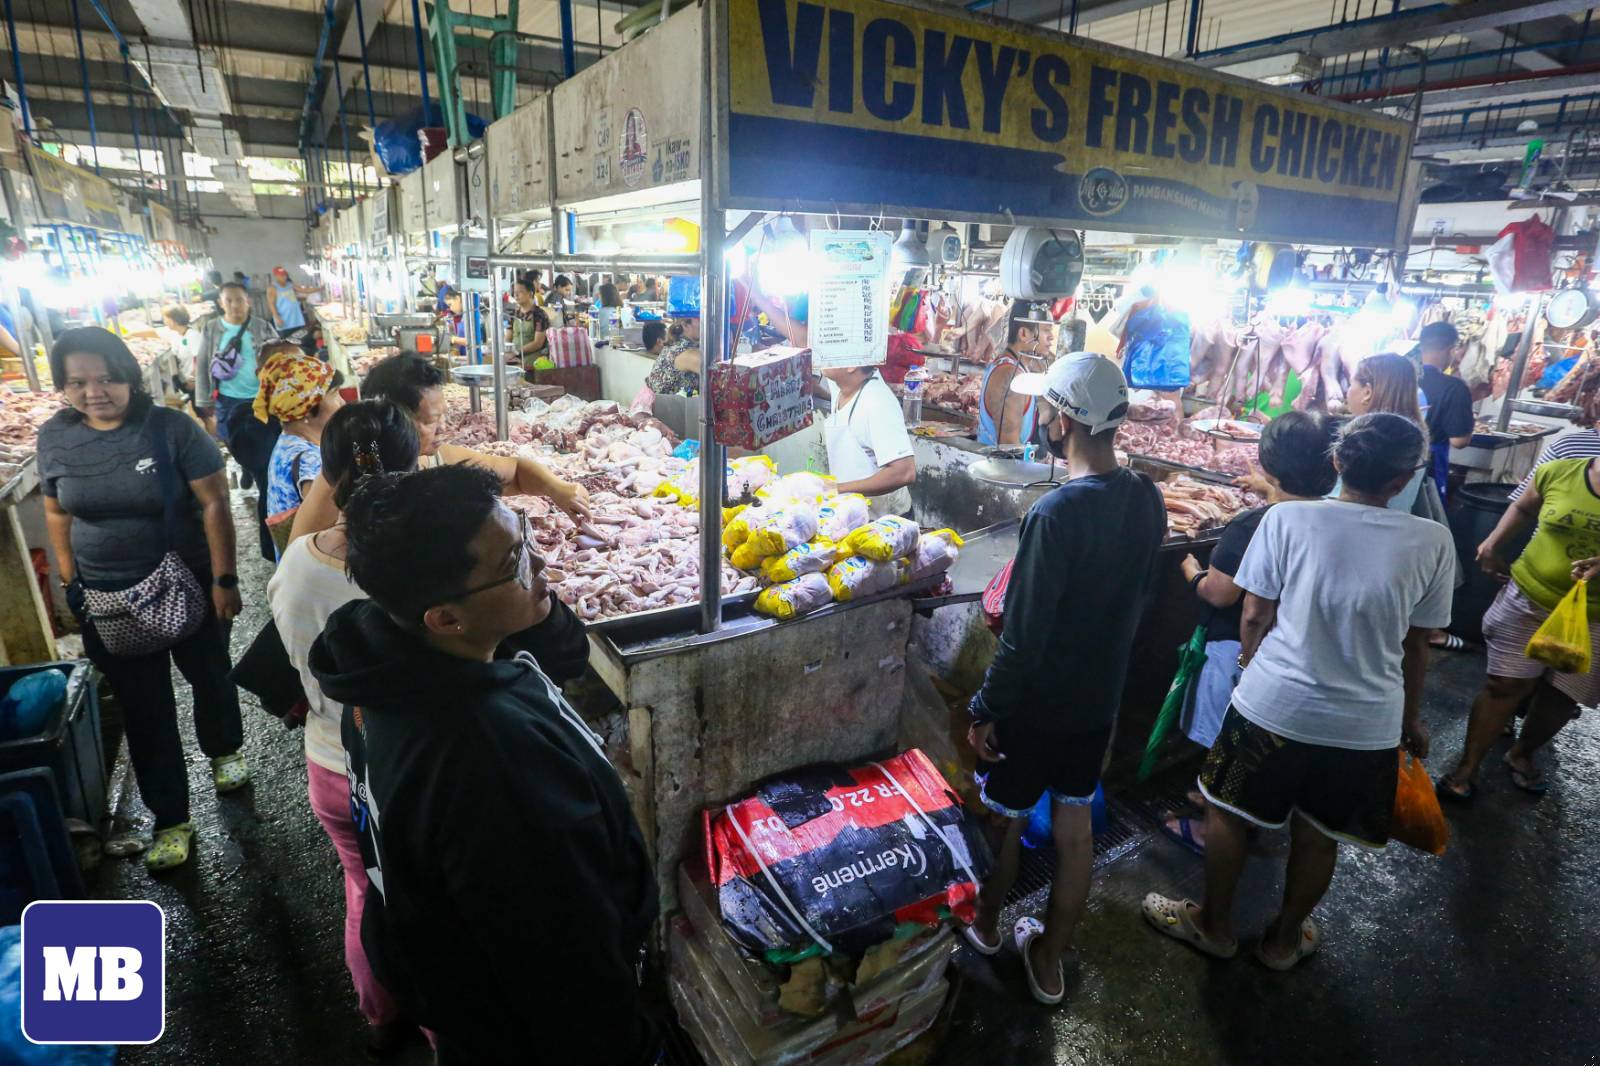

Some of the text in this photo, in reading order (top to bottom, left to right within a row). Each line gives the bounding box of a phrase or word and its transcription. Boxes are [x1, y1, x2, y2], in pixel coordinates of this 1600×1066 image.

[757, 0, 1398, 191] VICKY'S FRESH CHICKEN
